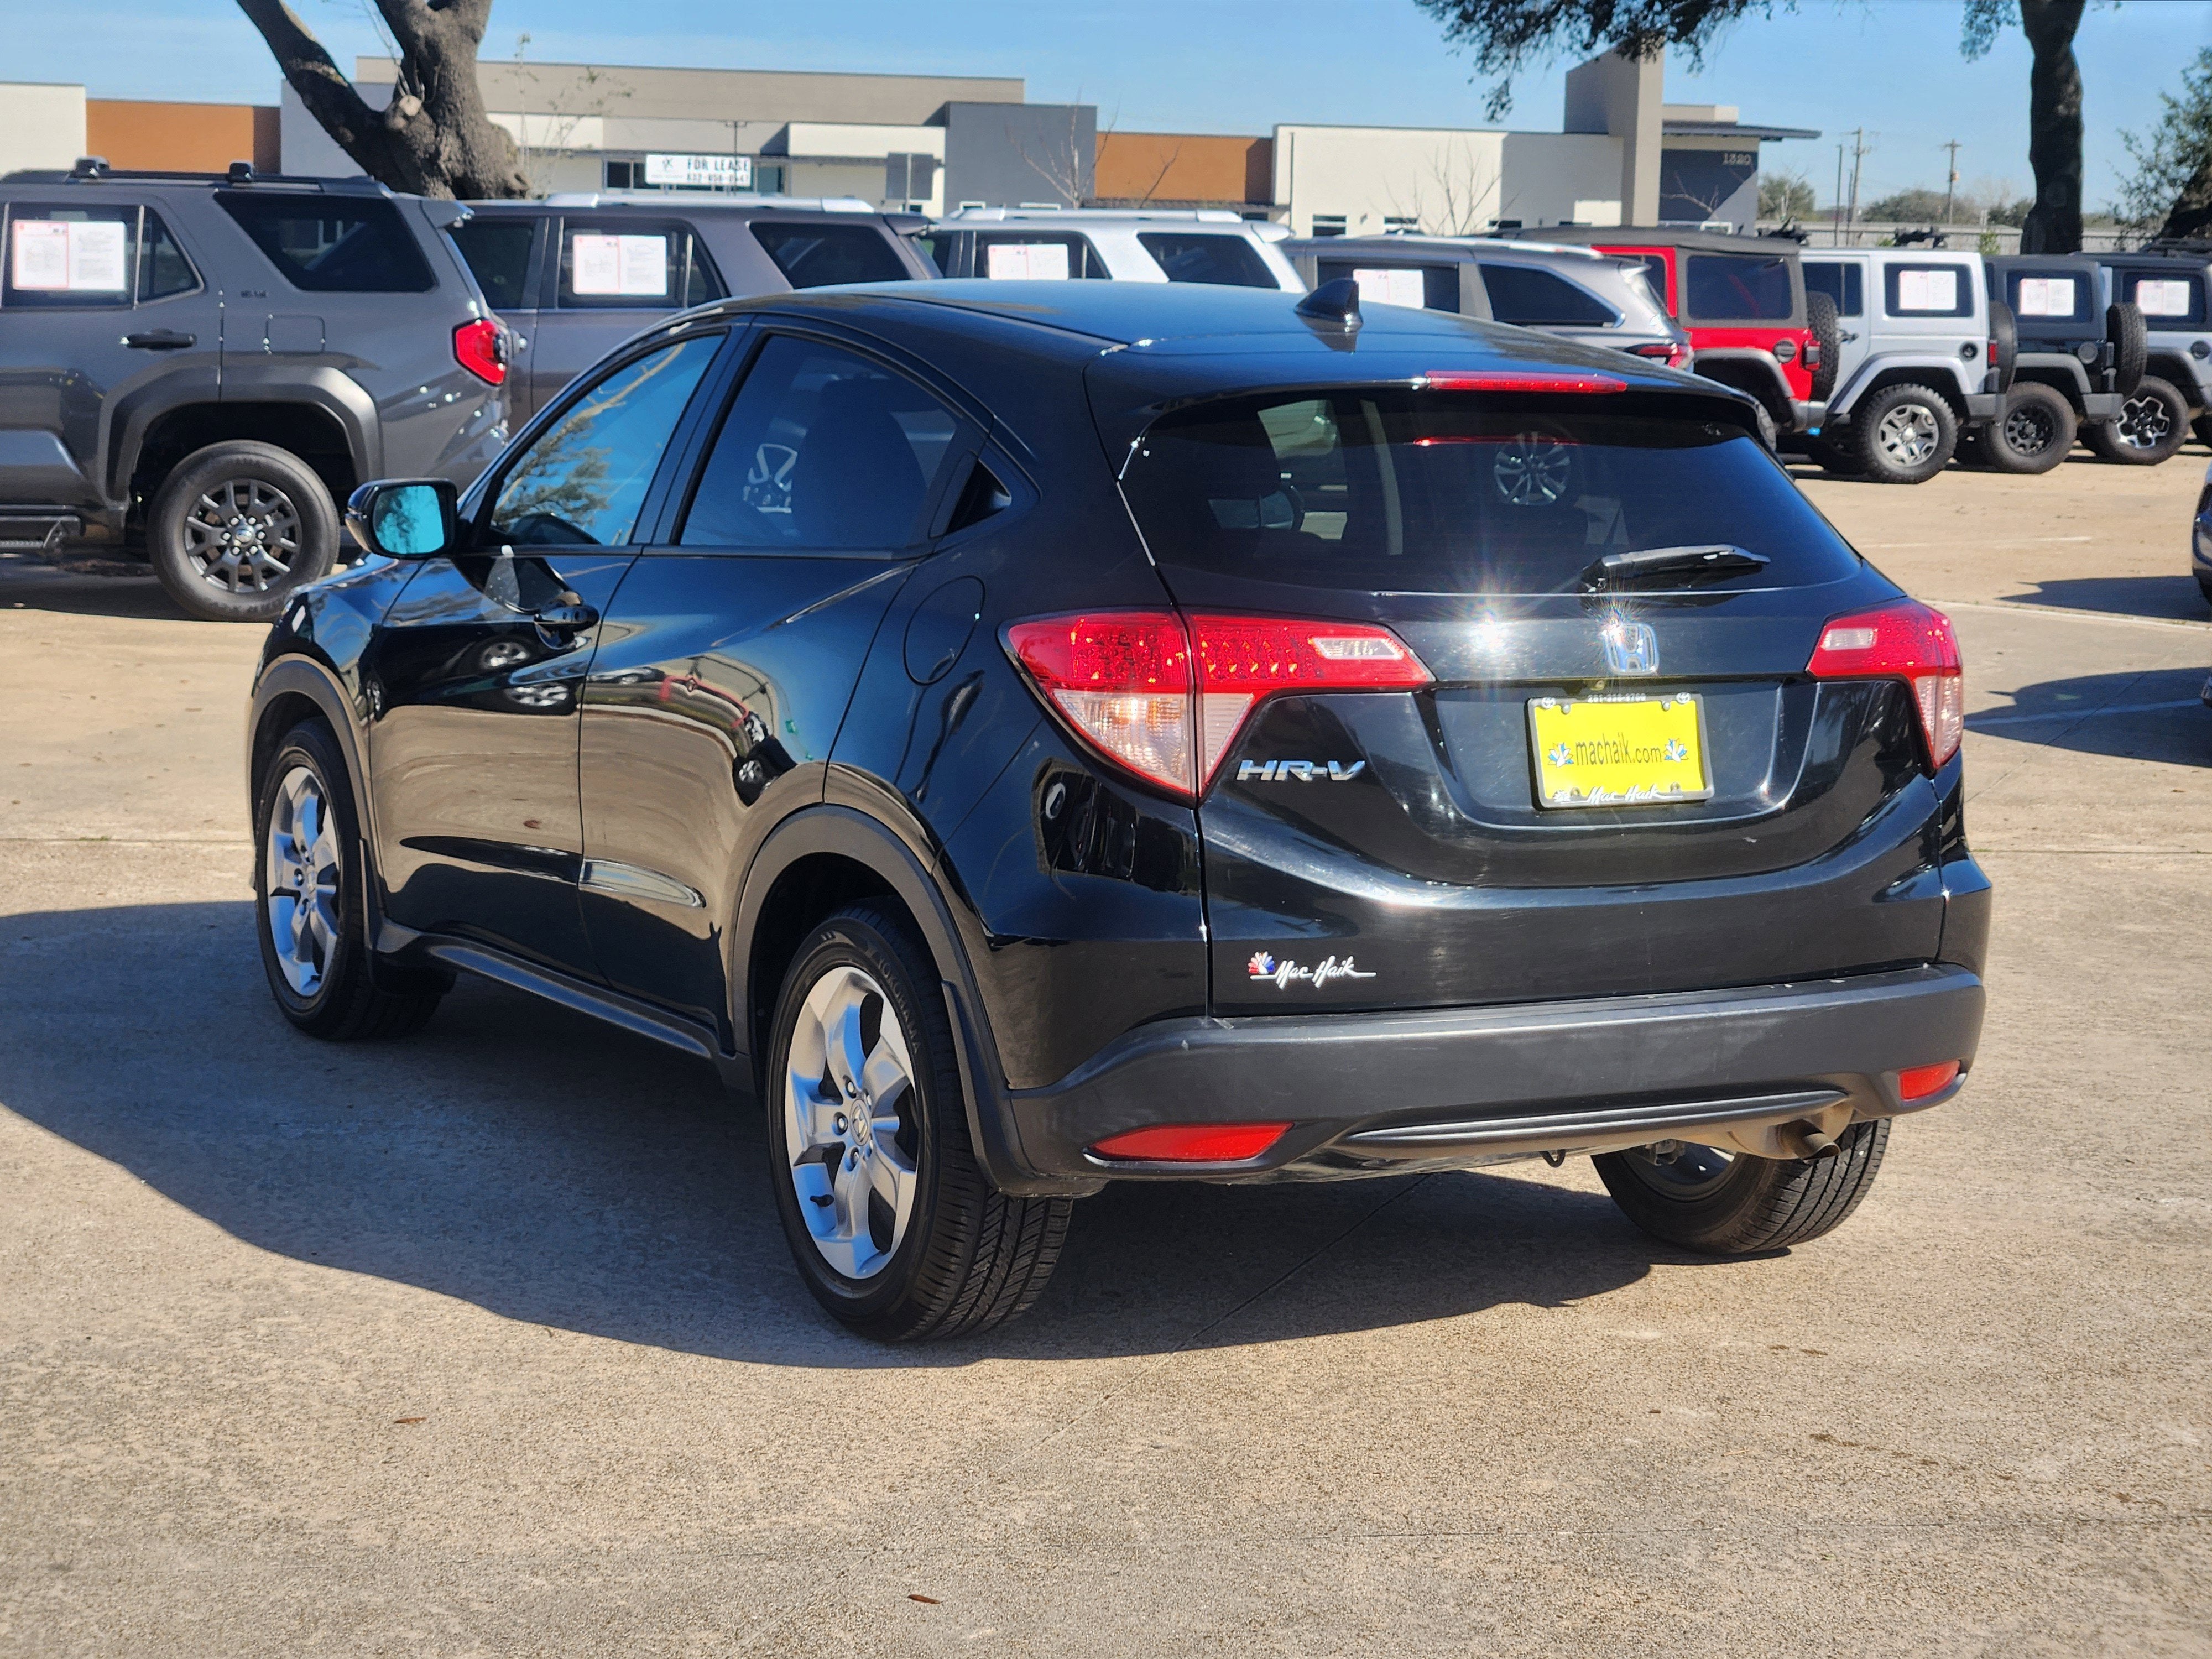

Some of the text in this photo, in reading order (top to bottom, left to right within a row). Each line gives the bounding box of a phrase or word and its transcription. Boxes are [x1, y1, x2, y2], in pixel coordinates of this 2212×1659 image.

[687, 158, 748, 171] FOR LEASE
[1575, 732, 1663, 766] machaik.com
[1237, 759, 1366, 781] HR-V
[1274, 954, 1377, 989] Mac Haik
